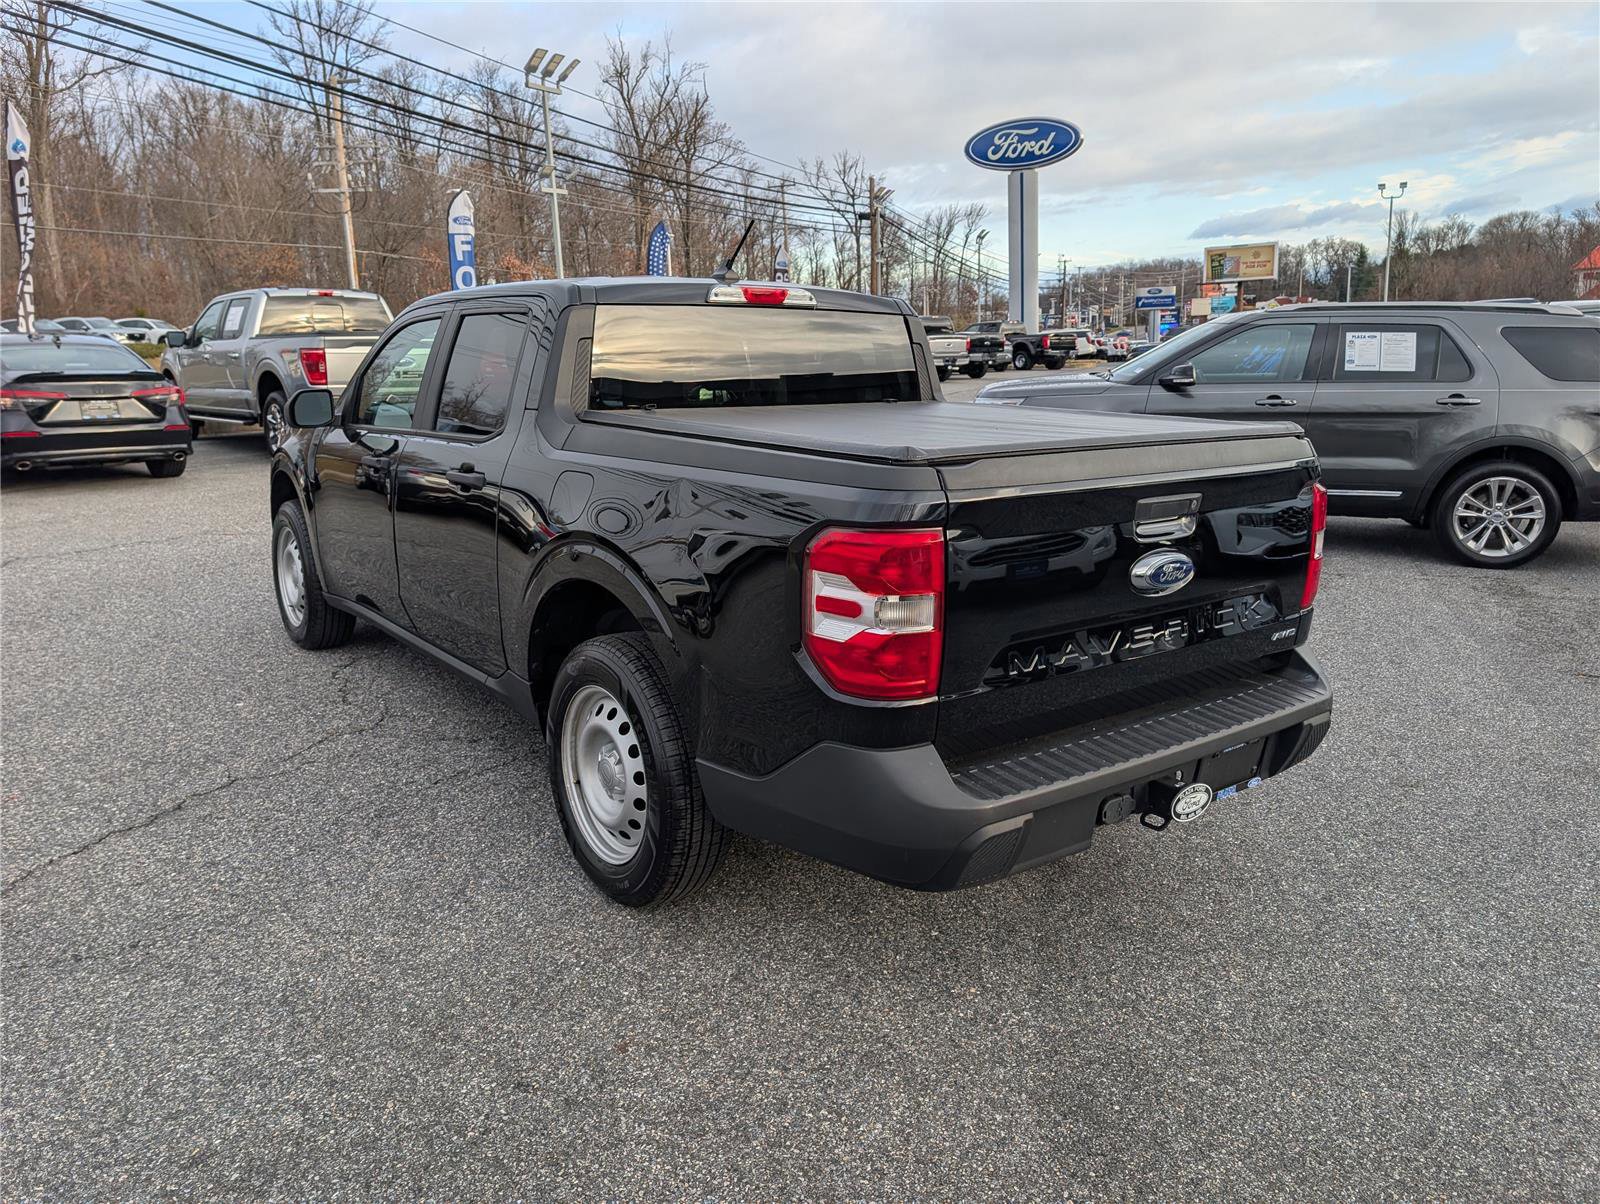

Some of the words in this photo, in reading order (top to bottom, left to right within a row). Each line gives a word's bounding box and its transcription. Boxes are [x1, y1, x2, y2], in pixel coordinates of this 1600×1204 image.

[987, 127, 1056, 161] Ford
[1160, 563, 1187, 582] Ford
[1008, 596, 1264, 676] MAVERICK
